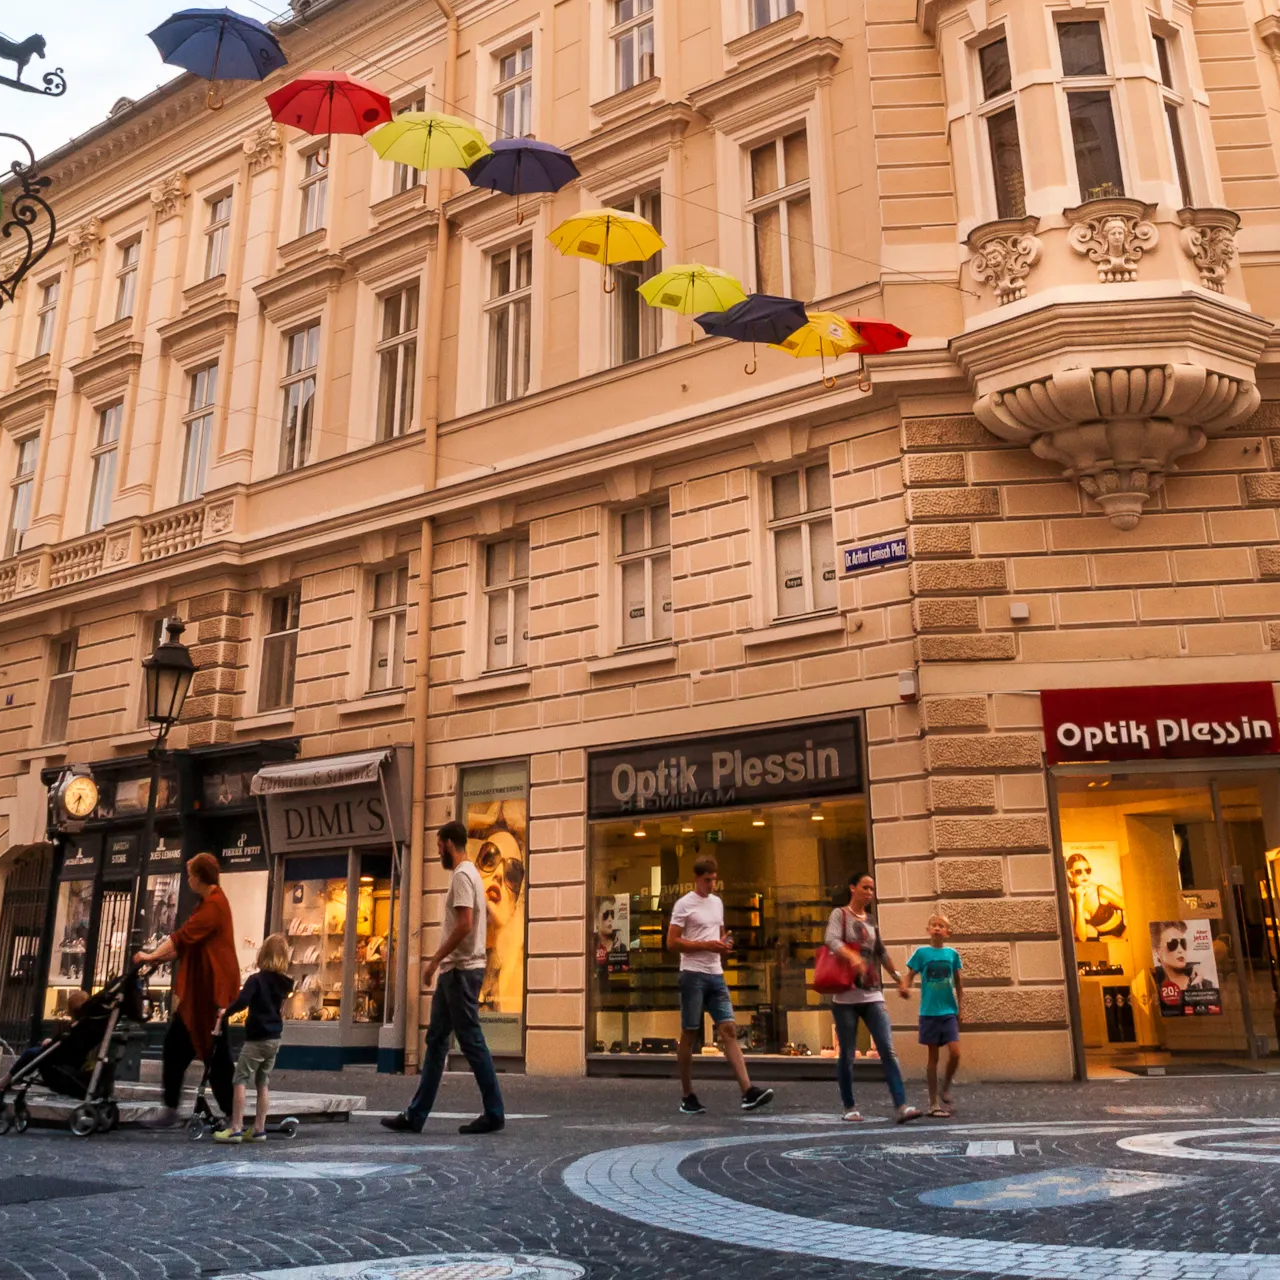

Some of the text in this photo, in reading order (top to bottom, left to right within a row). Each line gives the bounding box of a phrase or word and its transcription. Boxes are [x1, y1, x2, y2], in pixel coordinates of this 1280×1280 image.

[852, 549, 869, 565] Arthur
[869, 545, 891, 562] Lemisch
[891, 542, 906, 557] Platz
[1056, 716, 1273, 752] Optik Plessin
[259, 767, 373, 792] Edelsteine & Schmuck
[611, 739, 841, 809] Optik Plessin
[111, 854, 127, 864] STORE
[161, 849, 182, 859] LEMANS
[222, 847, 243, 857] PIERRE
[1193, 935, 1209, 943] jetzt
